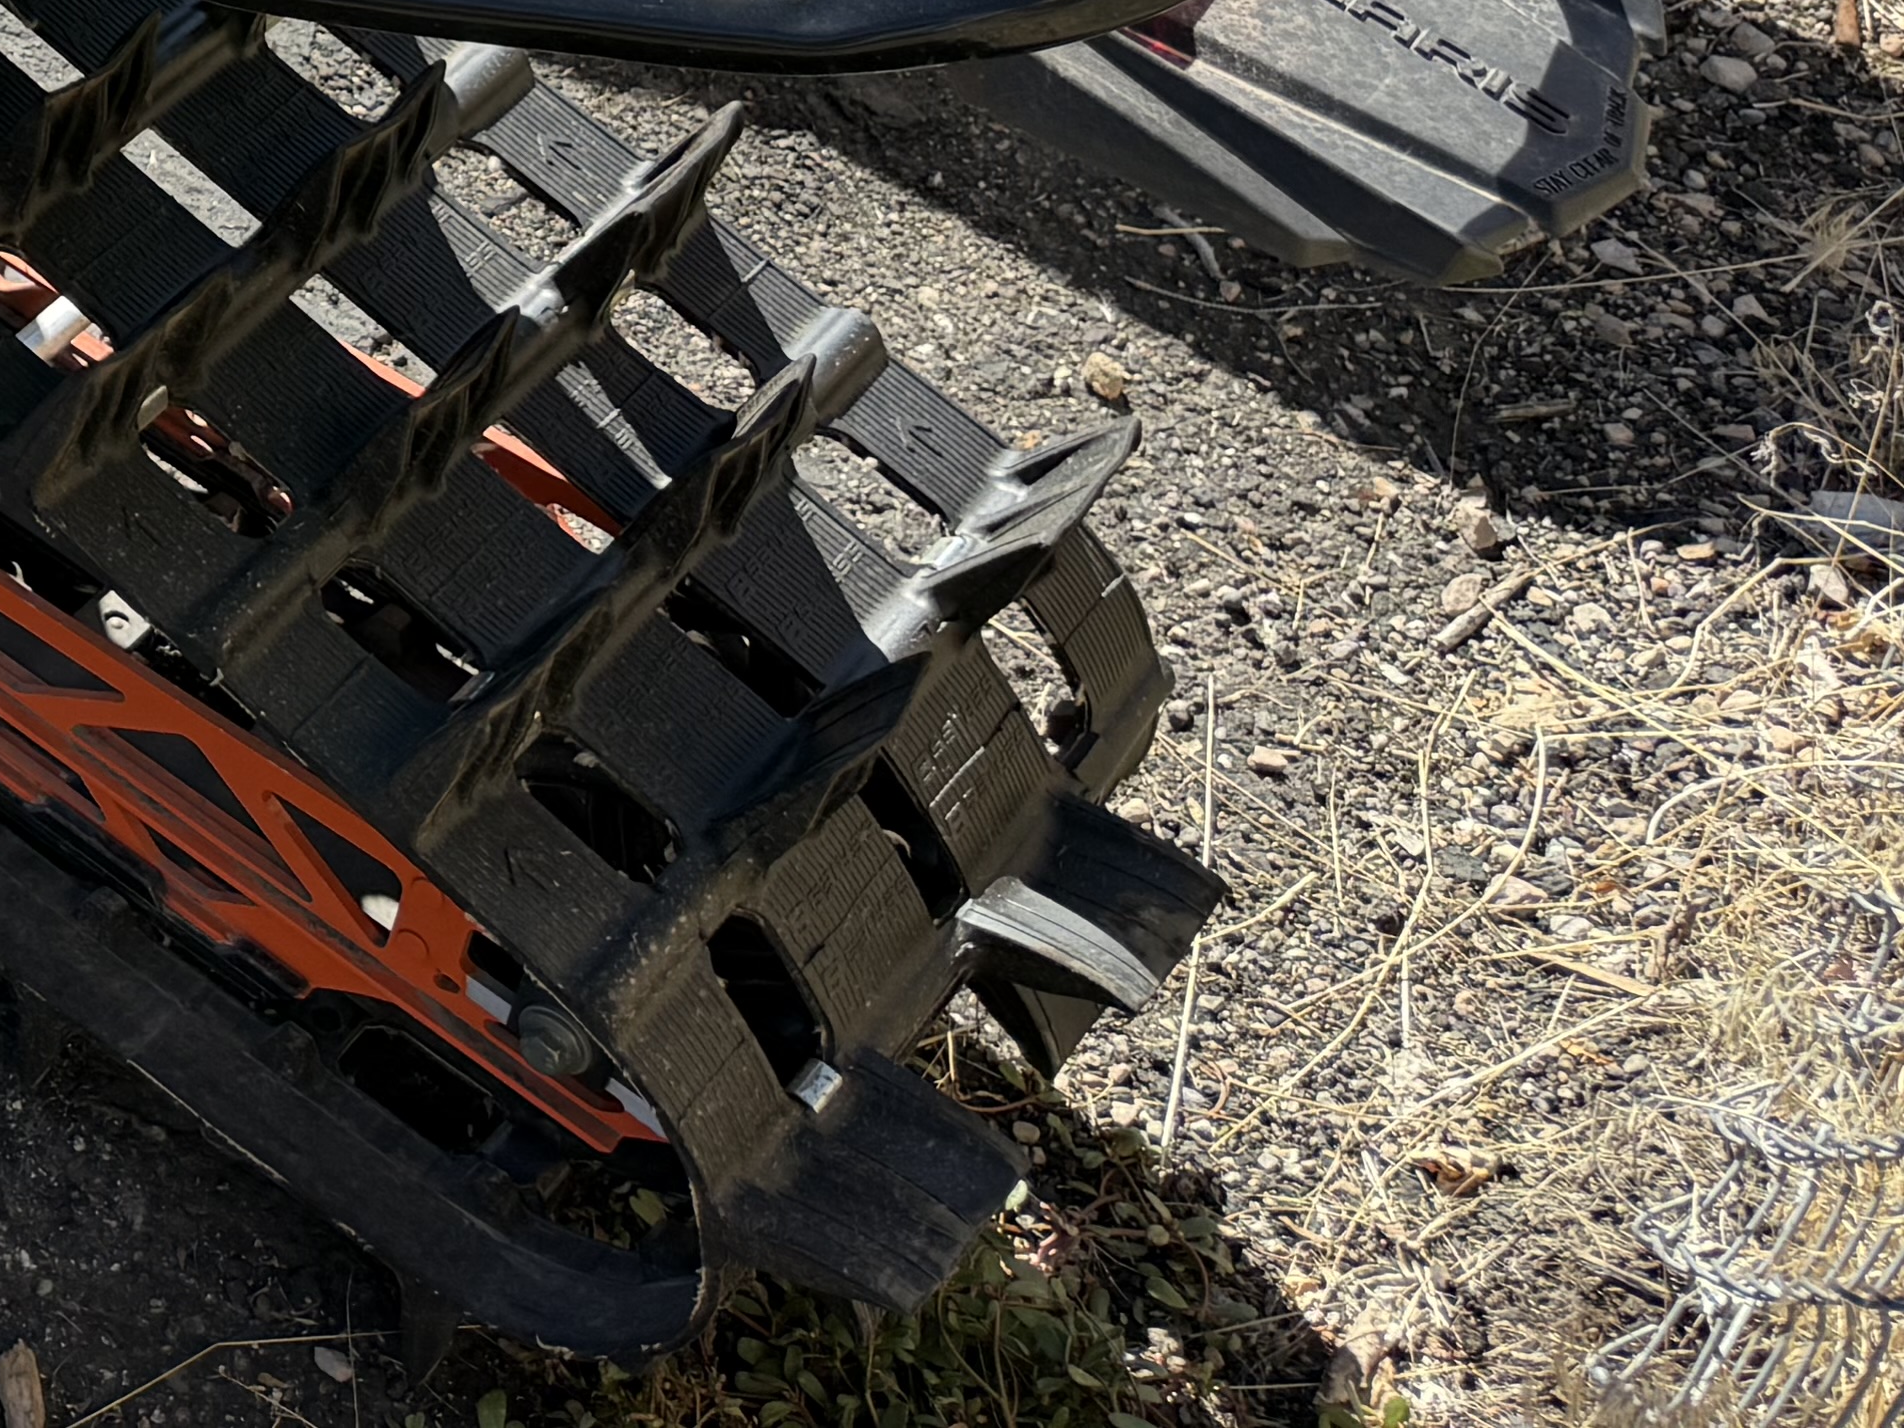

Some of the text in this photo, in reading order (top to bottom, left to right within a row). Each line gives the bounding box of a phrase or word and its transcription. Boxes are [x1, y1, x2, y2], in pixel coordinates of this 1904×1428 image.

[1534, 169, 1573, 194] STAY
[1568, 147, 1620, 180] CLEAR
[1605, 86, 1628, 128] TRACK
